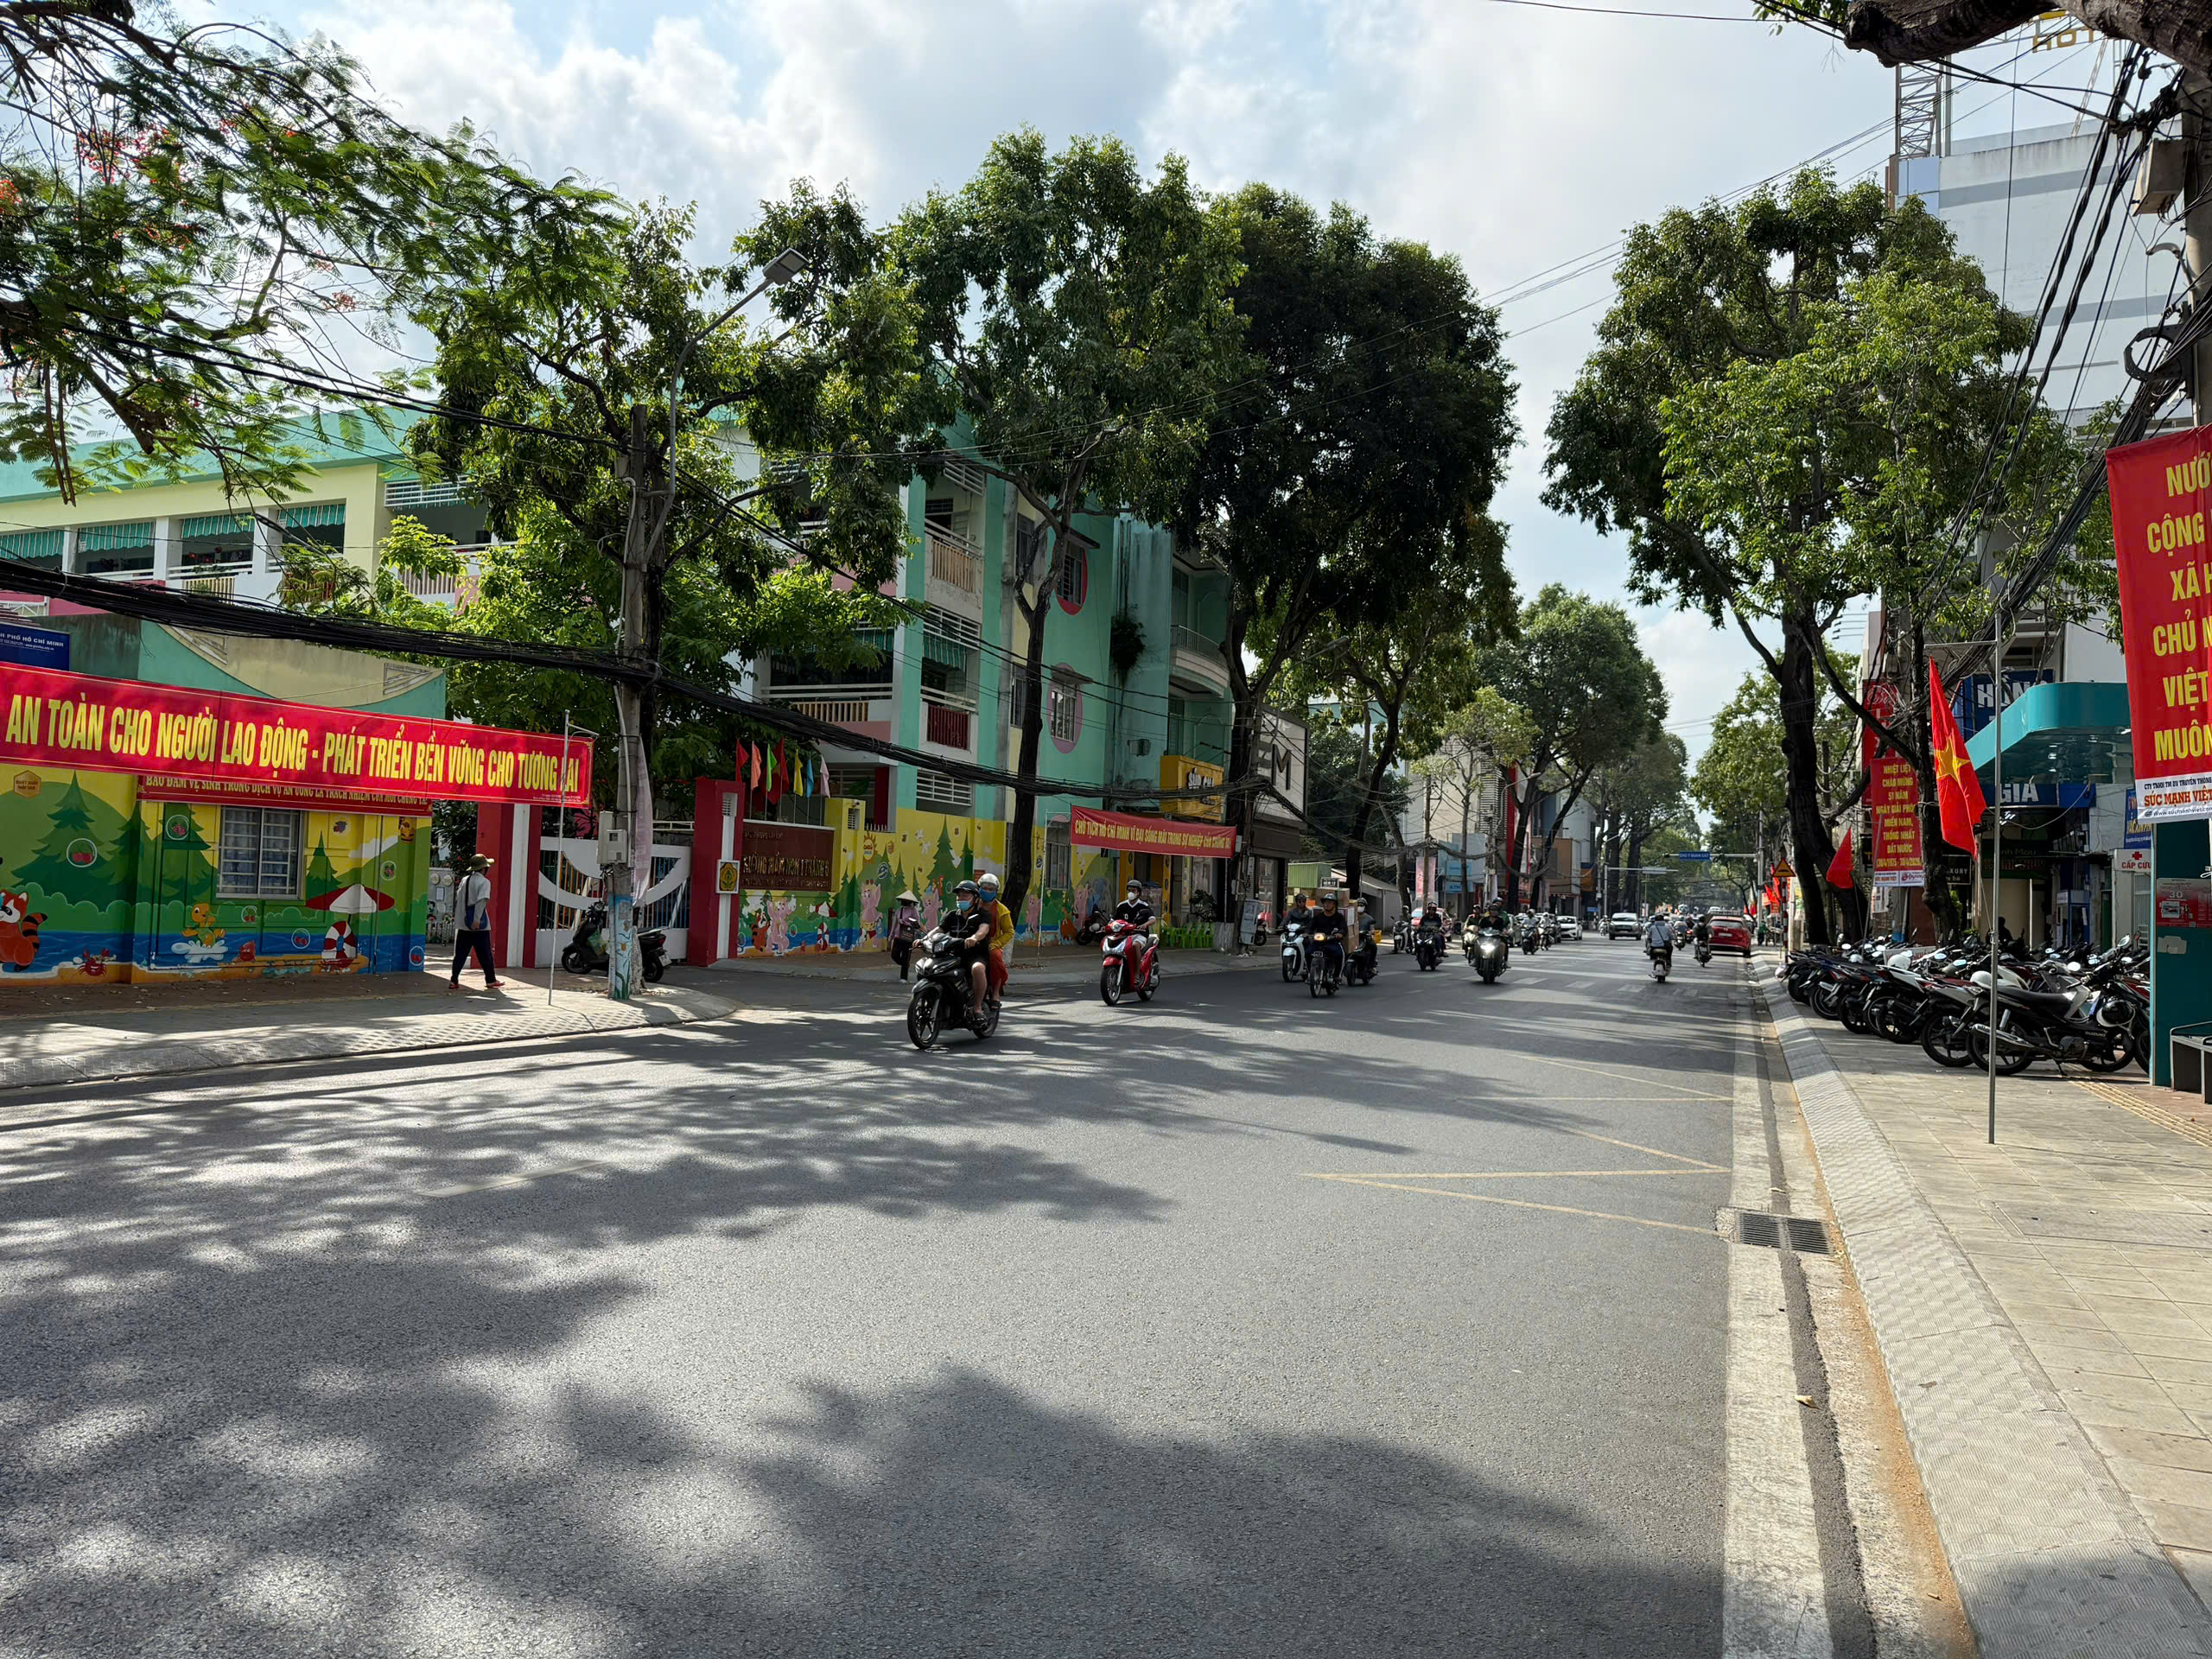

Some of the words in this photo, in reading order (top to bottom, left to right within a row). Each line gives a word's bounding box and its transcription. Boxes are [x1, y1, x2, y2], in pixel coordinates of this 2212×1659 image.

[2165, 451, 2212, 498] NƯỚ
[2147, 512, 2205, 556] CỘNG
[2170, 561, 2201, 601] XÃ
[2152, 608, 2196, 657] CHỦ
[2163, 666, 2209, 711] VIỆT
[5, 694, 41, 745] AN
[48, 691, 105, 752] TOÀN
[109, 706, 152, 756] CHO
[156, 706, 219, 762] NGƯỜI
[220, 720, 257, 766] LAO
[259, 716, 308, 778] ĐỘNG
[322, 726, 366, 775] PHÁT
[369, 723, 413, 779] TRIỂN
[414, 730, 445, 782] BỀN
[448, 739, 485, 785] VỮNG
[487, 749, 514, 788] CHO
[518, 750, 557, 791] TƯƠNG
[2144, 790, 2163, 807] SỨC
[2164, 791, 2191, 807] MẠNH
[2192, 785, 2212, 804] VIỆT
[2121, 860, 2136, 869] CẤP
